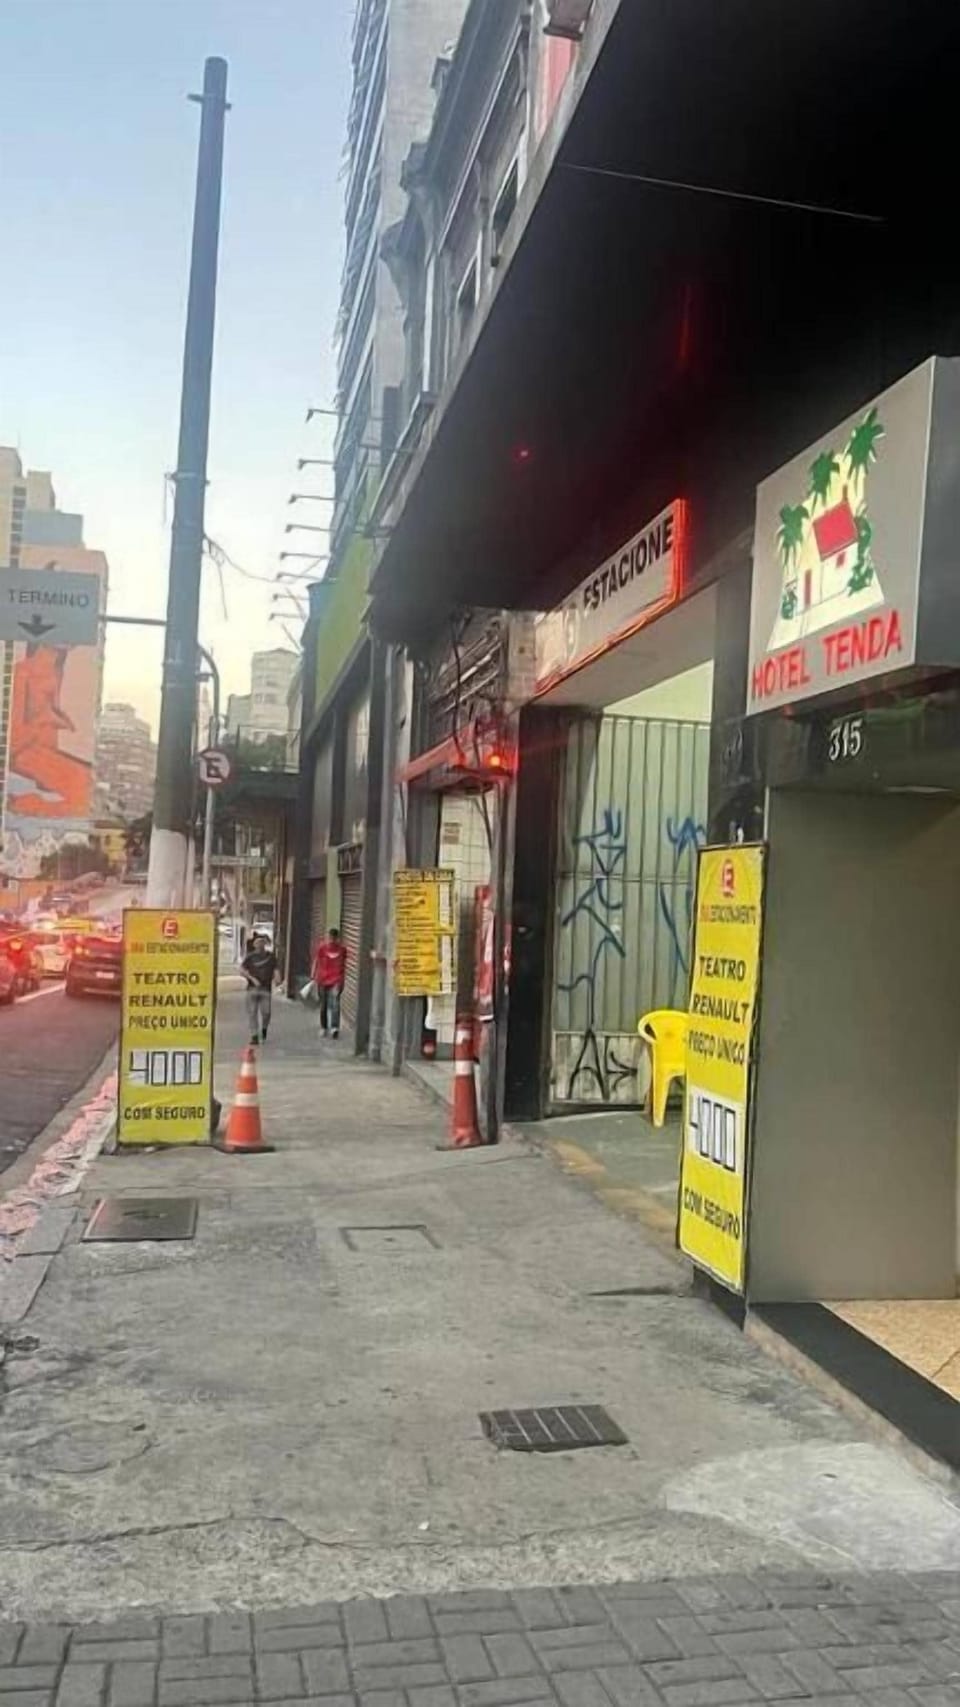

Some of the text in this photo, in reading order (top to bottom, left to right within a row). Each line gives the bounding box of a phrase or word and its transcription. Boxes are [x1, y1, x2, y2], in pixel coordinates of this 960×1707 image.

[583, 514, 674, 611] ESTACIONE
[753, 610, 903, 699] HOTEL TENDA
[829, 718, 863, 761] 315
[133, 972, 200, 985] TEATRO
[700, 956, 746, 982] TEATRO
[129, 995, 208, 1007] RENAULT
[693, 994, 750, 1024] RENAULT
[128, 1015, 167, 1031] PREÇO
[124, 1106, 206, 1120] COM SEGURO
[684, 1188, 741, 1240] COM SEGURO
